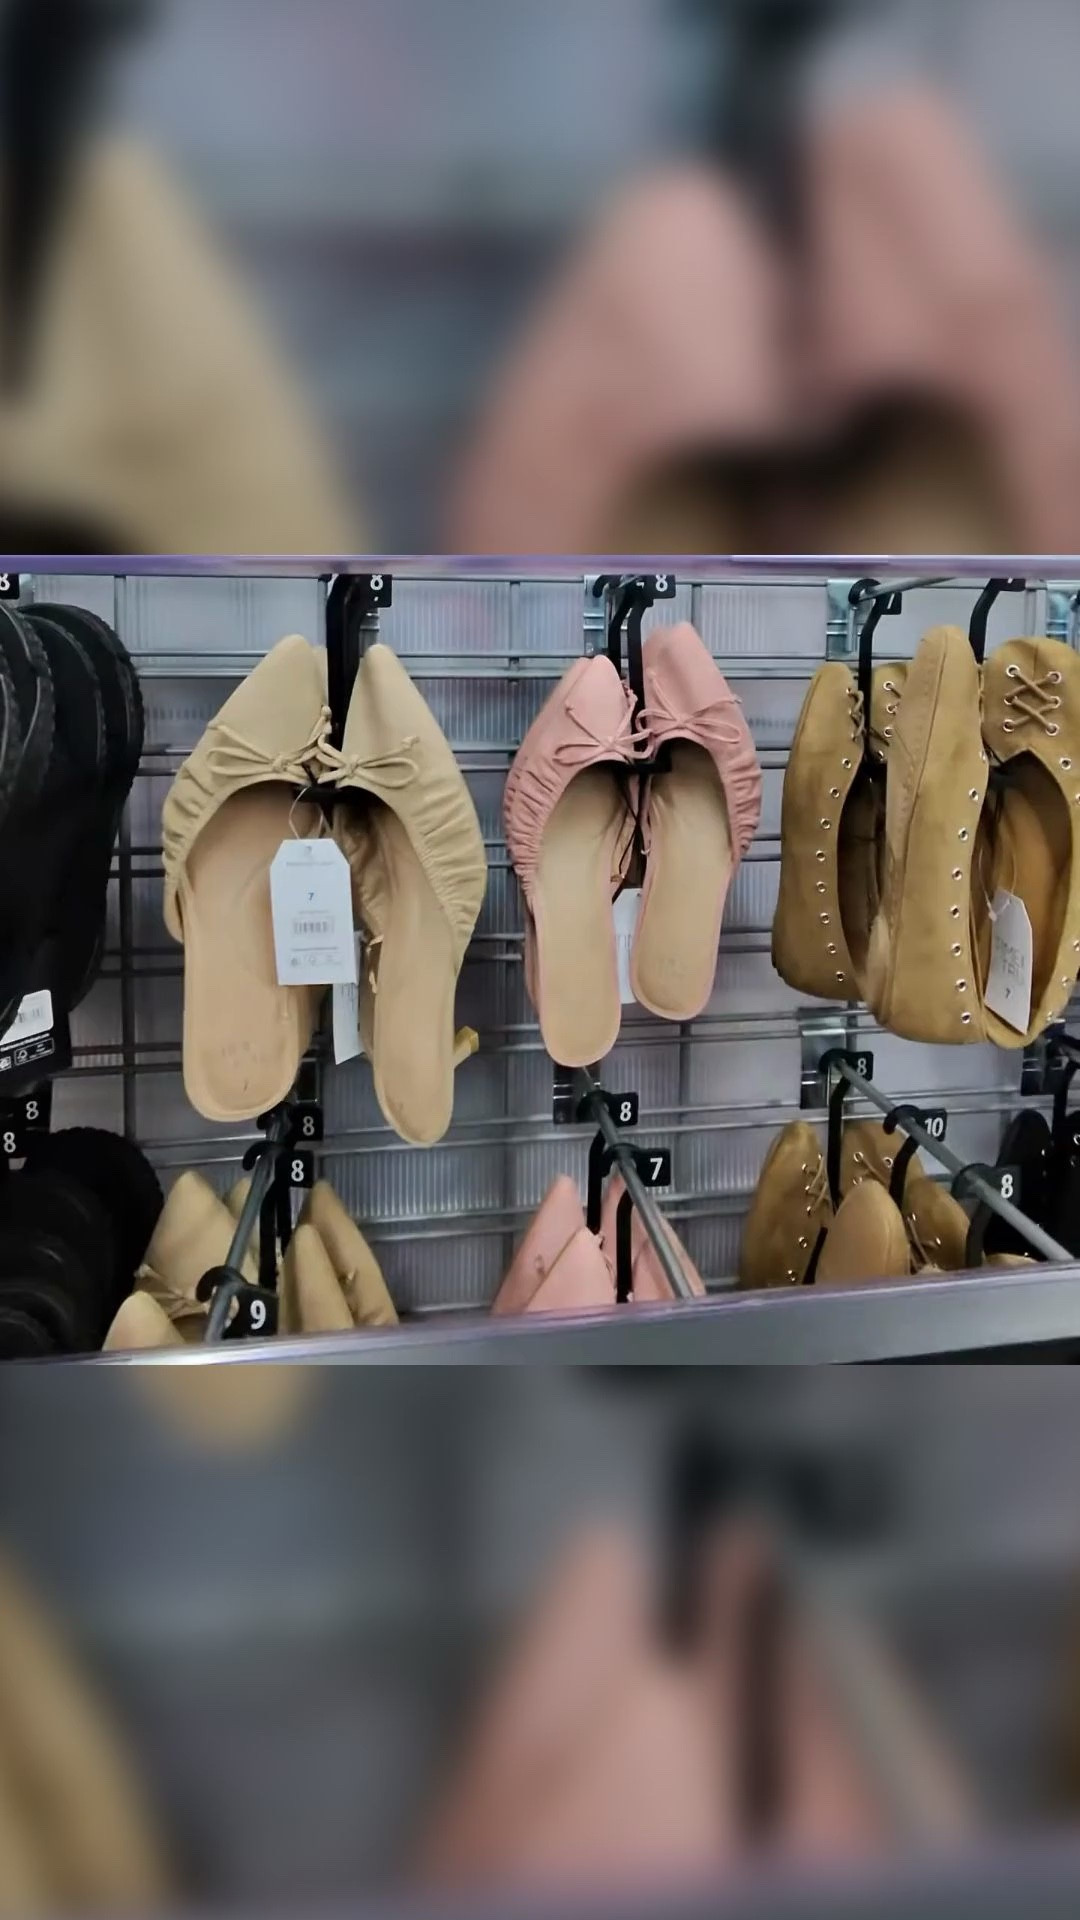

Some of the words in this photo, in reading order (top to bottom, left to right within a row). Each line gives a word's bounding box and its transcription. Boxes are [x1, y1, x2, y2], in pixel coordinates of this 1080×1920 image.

[655, 574, 668, 592] 8
[308, 892, 315, 902] 7
[857, 1058, 867, 1076] 8
[26, 1100, 39, 1120] 8
[620, 1101, 632, 1122] 8
[303, 1116, 315, 1136] 8
[924, 1117, 944, 1137] 10
[3, 1131, 16, 1153] 8
[291, 1159, 304, 1182] 8
[650, 1157, 663, 1181] 7
[1001, 1173, 1013, 1199] 8
[250, 1300, 266, 1330] 9
